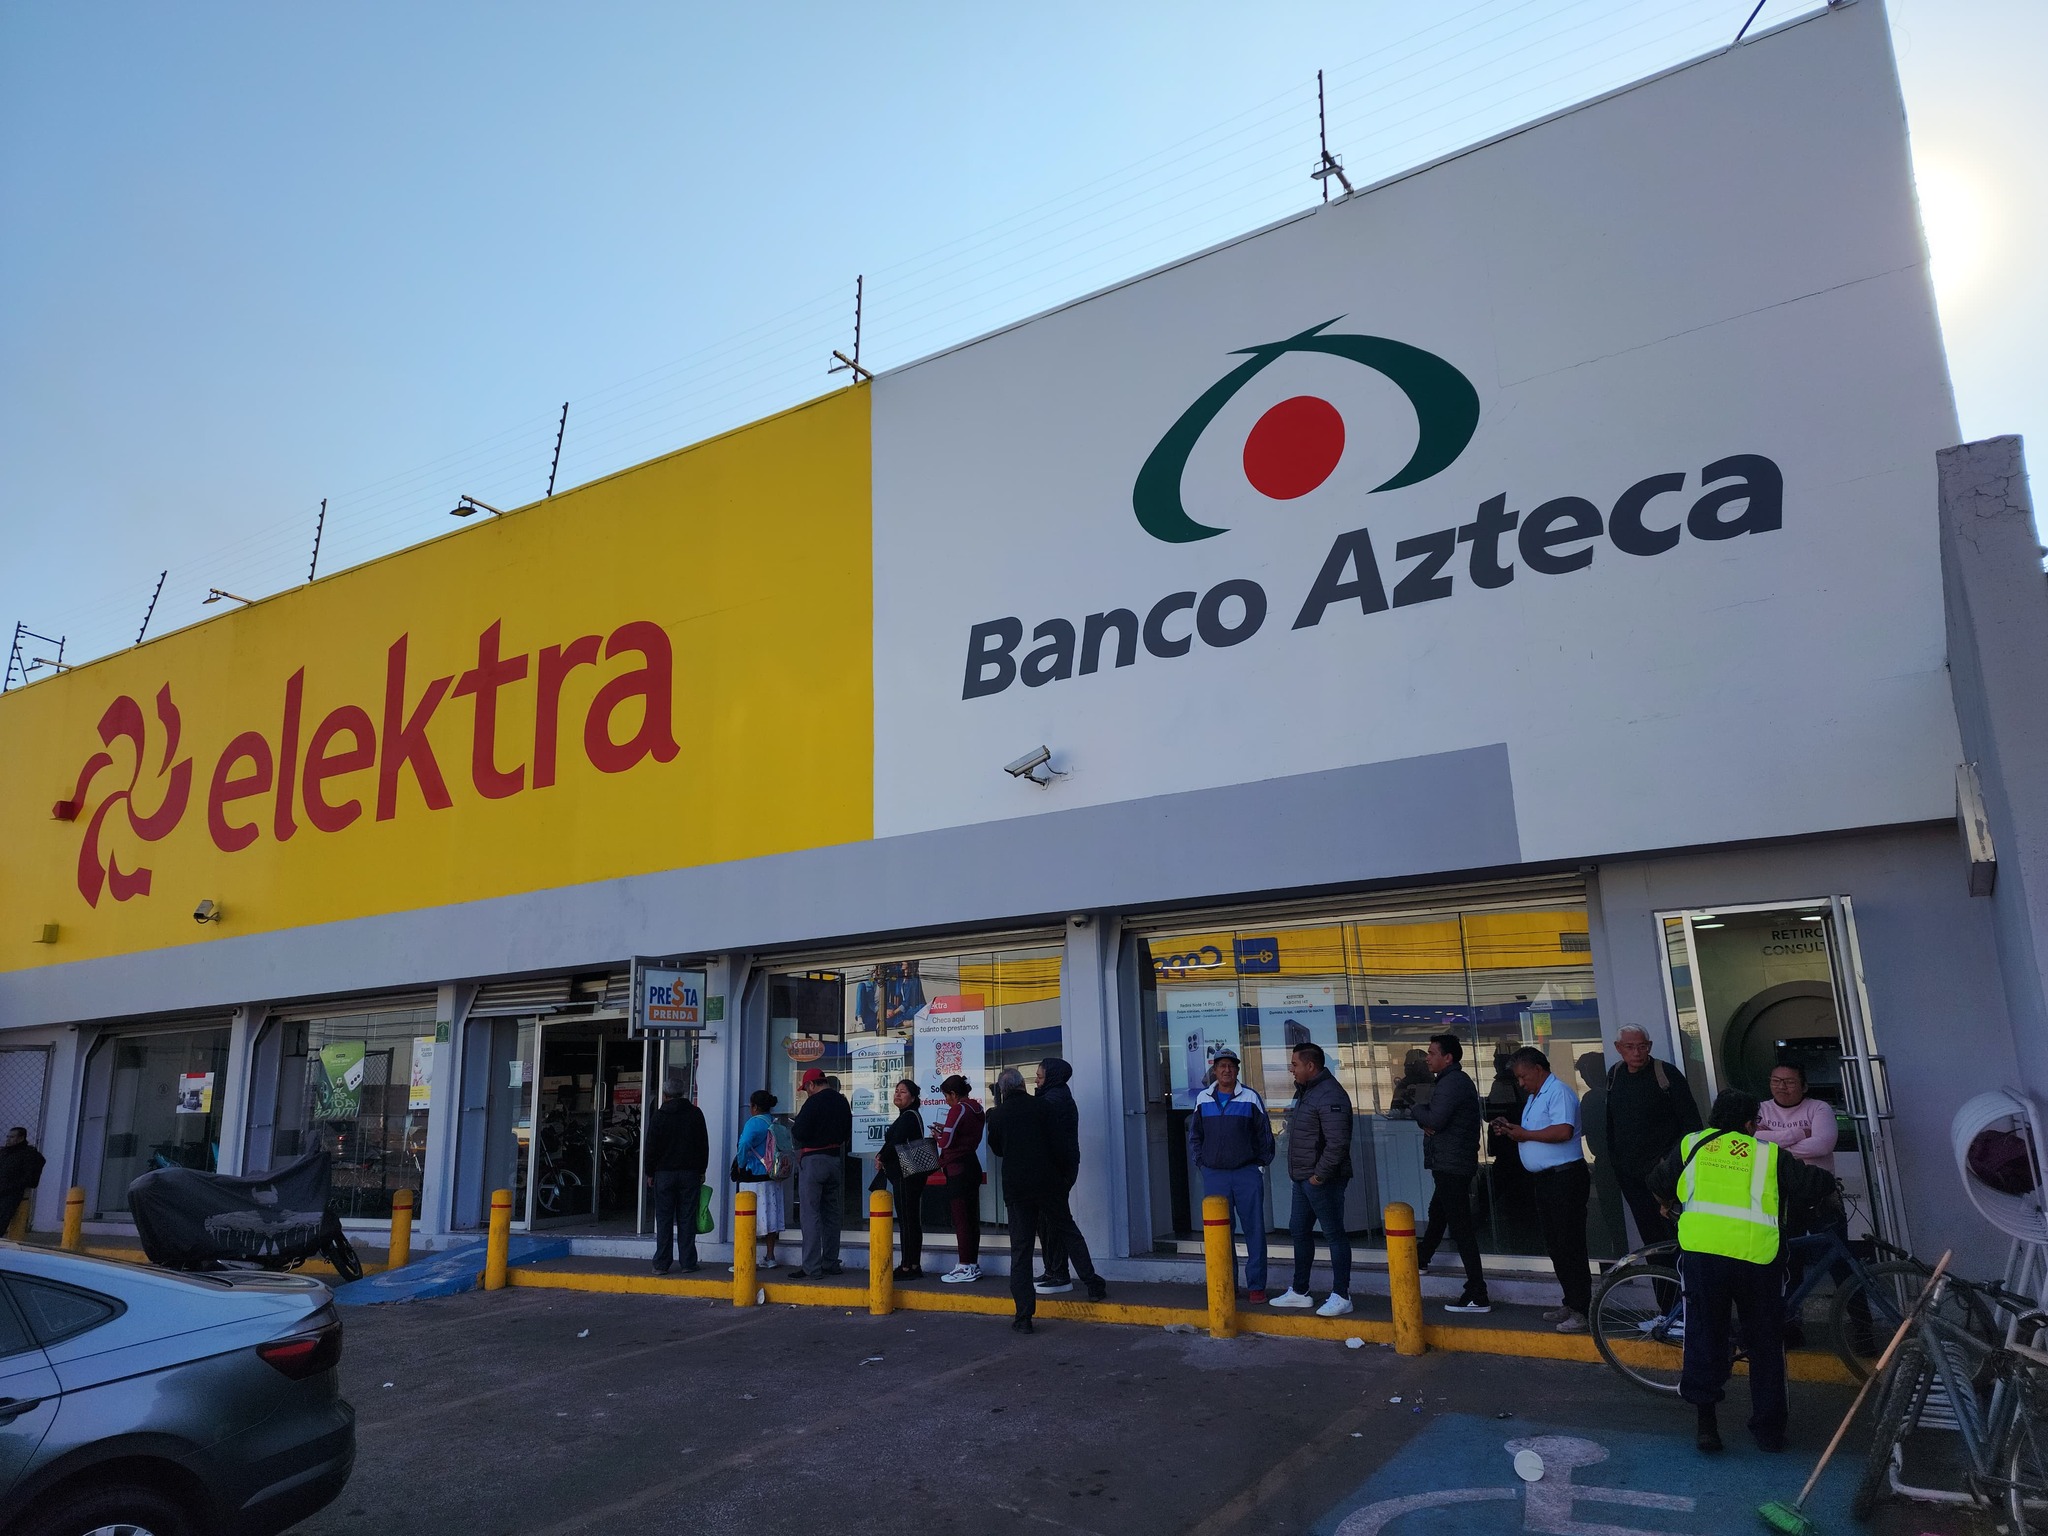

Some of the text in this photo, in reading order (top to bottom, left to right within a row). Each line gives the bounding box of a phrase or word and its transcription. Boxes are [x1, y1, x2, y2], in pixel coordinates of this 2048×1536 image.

[962, 454, 1783, 700] Banco Azteca
[207, 617, 682, 853] elektra
[653, 1009, 694, 1020] PRENDA
[932, 1016, 951, 1024] Checa
[947, 1024, 979, 1033] prestamos
[793, 1040, 820, 1049] centro
[1767, 1120, 1809, 1128] FOLLOWER
[1700, 1156, 1731, 1165] GOBIERNO
